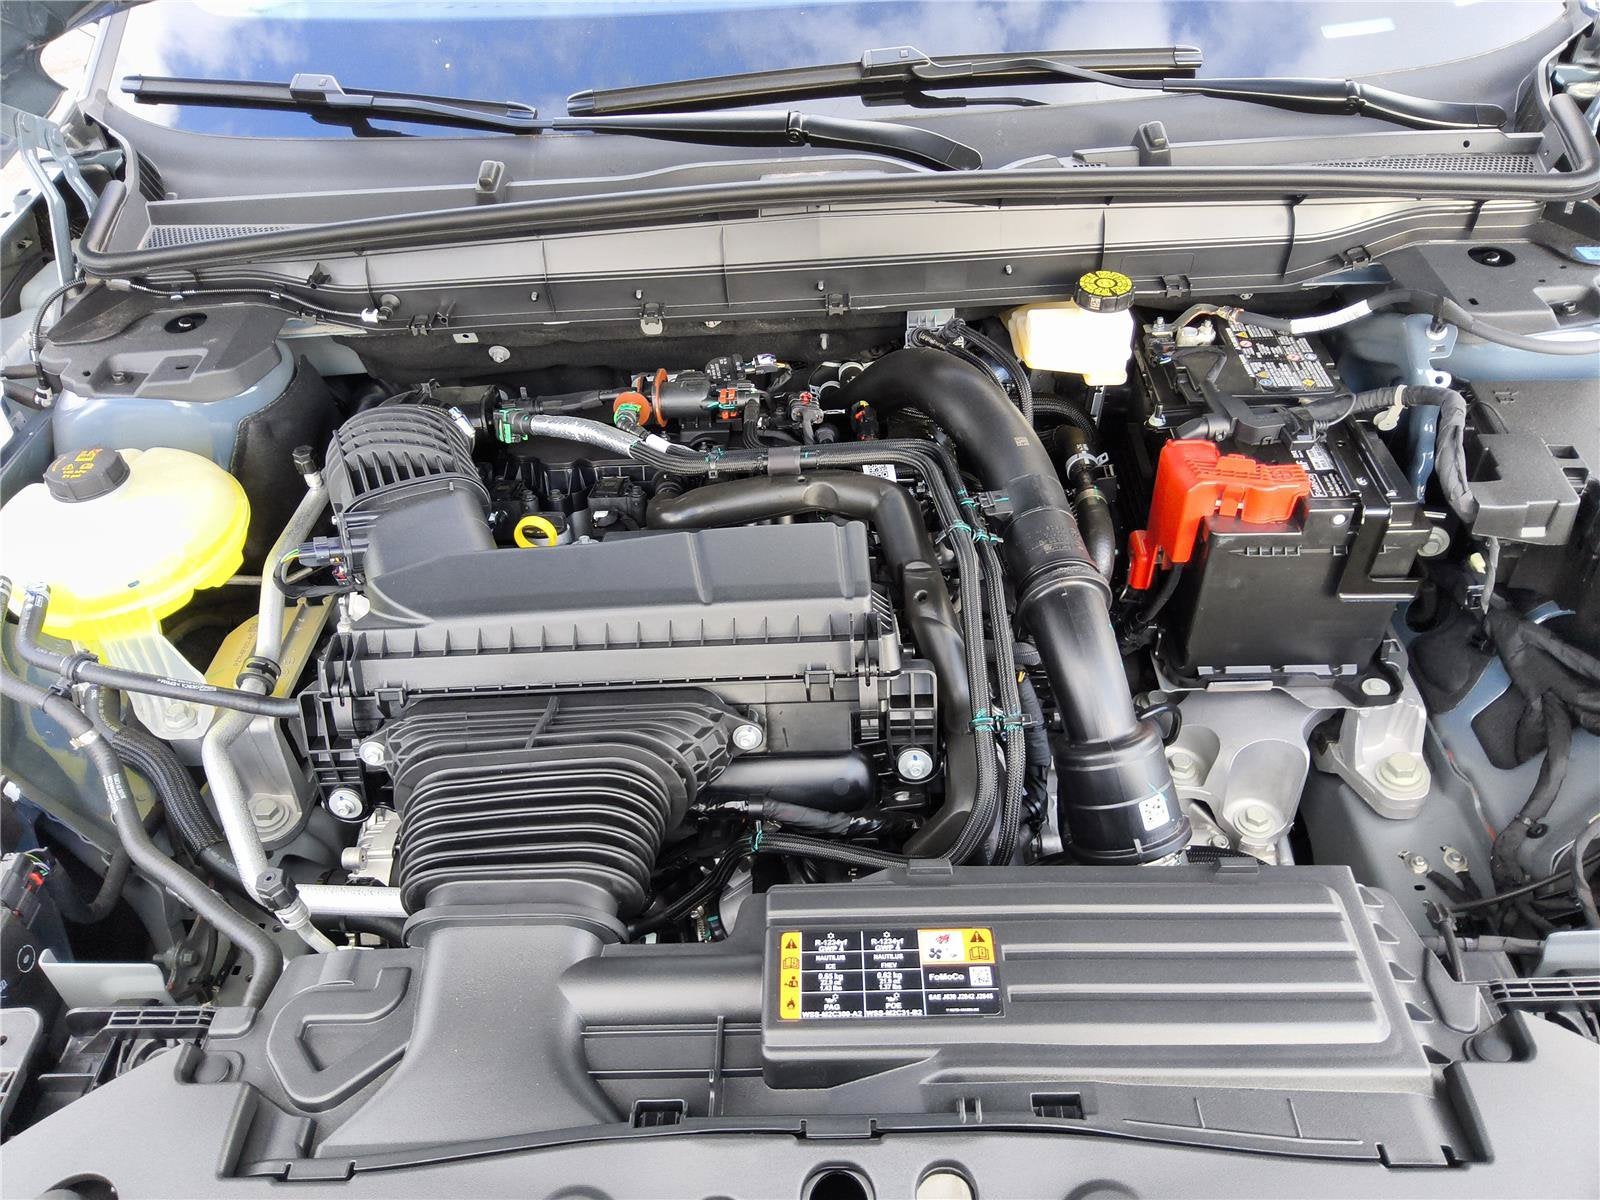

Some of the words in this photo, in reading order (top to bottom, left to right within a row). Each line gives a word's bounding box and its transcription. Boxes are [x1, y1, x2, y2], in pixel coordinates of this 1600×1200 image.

[814, 938, 848, 947] R-1234yf
[870, 937, 904, 946] R-1234yf
[834, 972, 844, 981] kg
[892, 971, 903, 980] kg
[928, 972, 965, 981] FoMoCo
[823, 1003, 841, 1011] PAG
